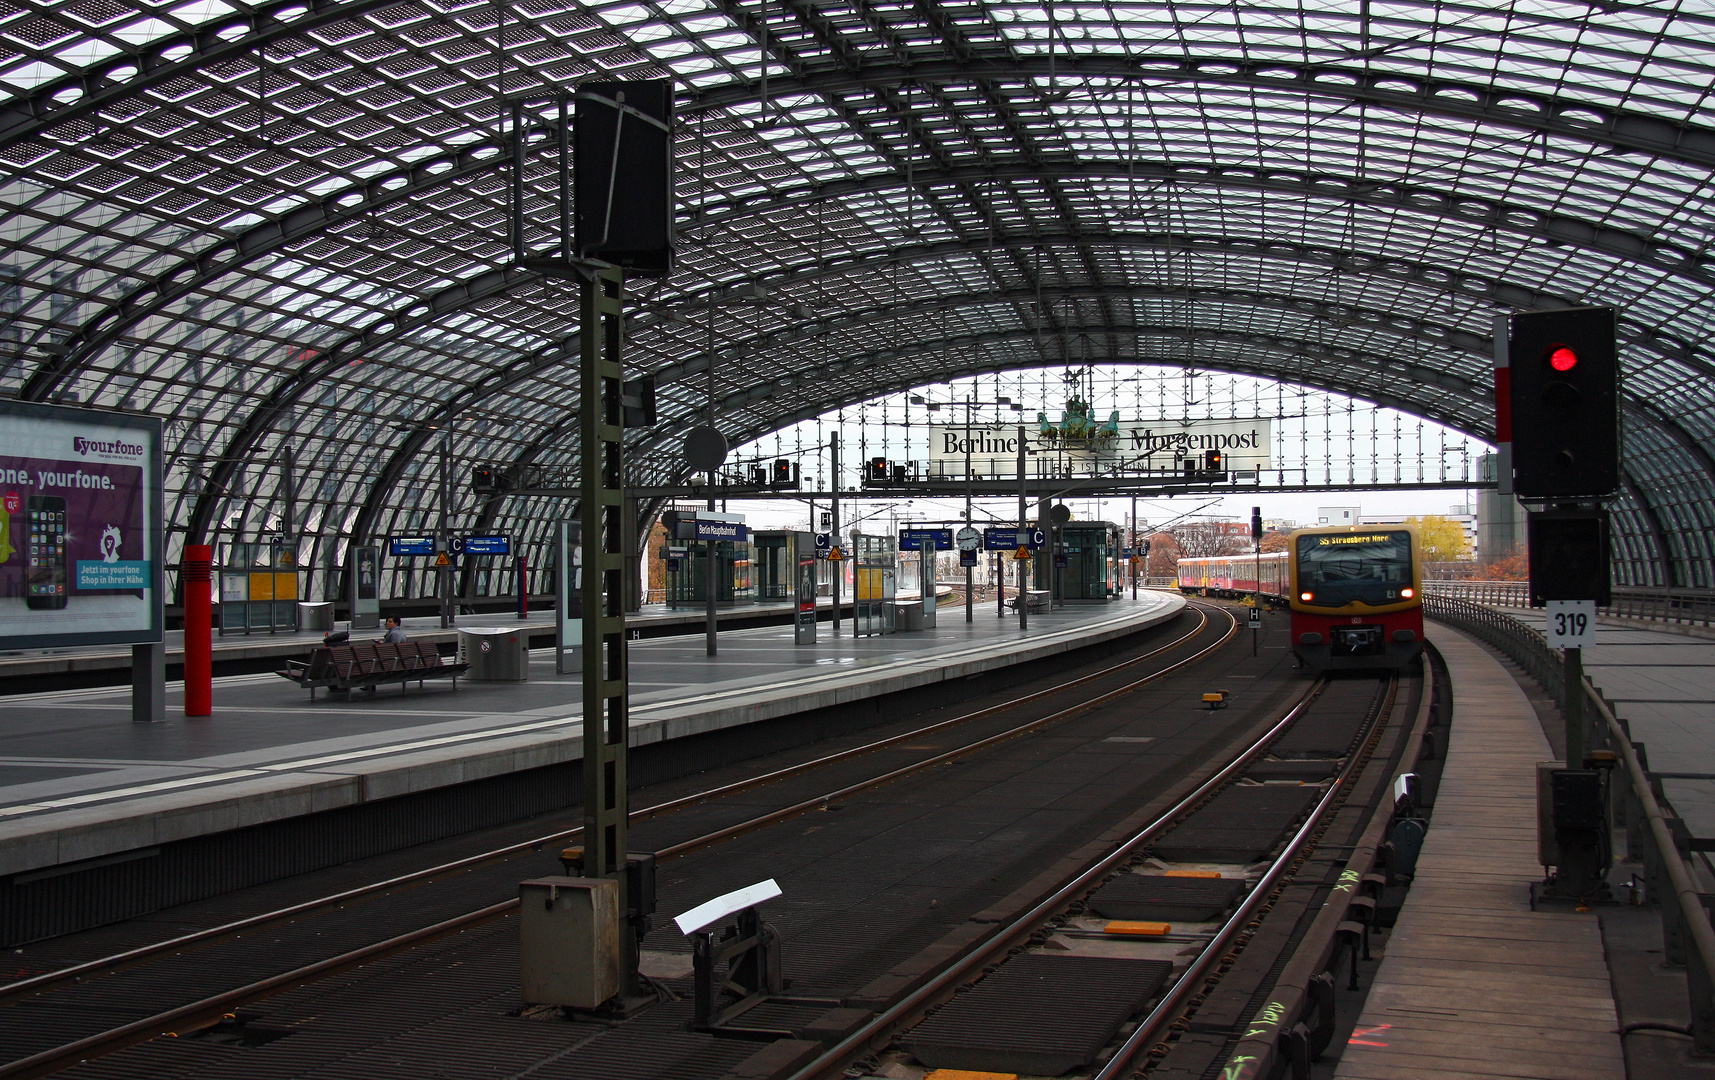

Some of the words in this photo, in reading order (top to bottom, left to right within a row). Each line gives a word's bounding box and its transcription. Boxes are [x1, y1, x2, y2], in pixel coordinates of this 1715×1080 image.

[80, 440, 144, 456] yourfone
[942, 431, 1018, 454] Berline
[1129, 429, 1260, 457] Morgenpost
[38, 470, 115, 490] yourfone.
[822, 513, 829, 524] H
[276, 521, 283, 531] H
[699, 524, 710, 535] Berlin
[711, 526, 736, 537] Hauptbahnhof
[815, 533, 825, 547] C
[1033, 531, 1043, 544] C
[1332, 536, 1370, 544] Strausberg
[453, 538, 461, 550] C
[81, 566, 99, 574] Jetzt
[100, 566, 109, 574] im
[110, 566, 140, 575] yourfone
[81, 575, 99, 586] Shop
[100, 575, 107, 584] in
[108, 576, 125, 584] Ihrer
[126, 575, 144, 584] Nähe
[1250, 609, 1258, 620] H
[1555, 613, 1587, 636] 319
[633, 630, 639, 640] H
